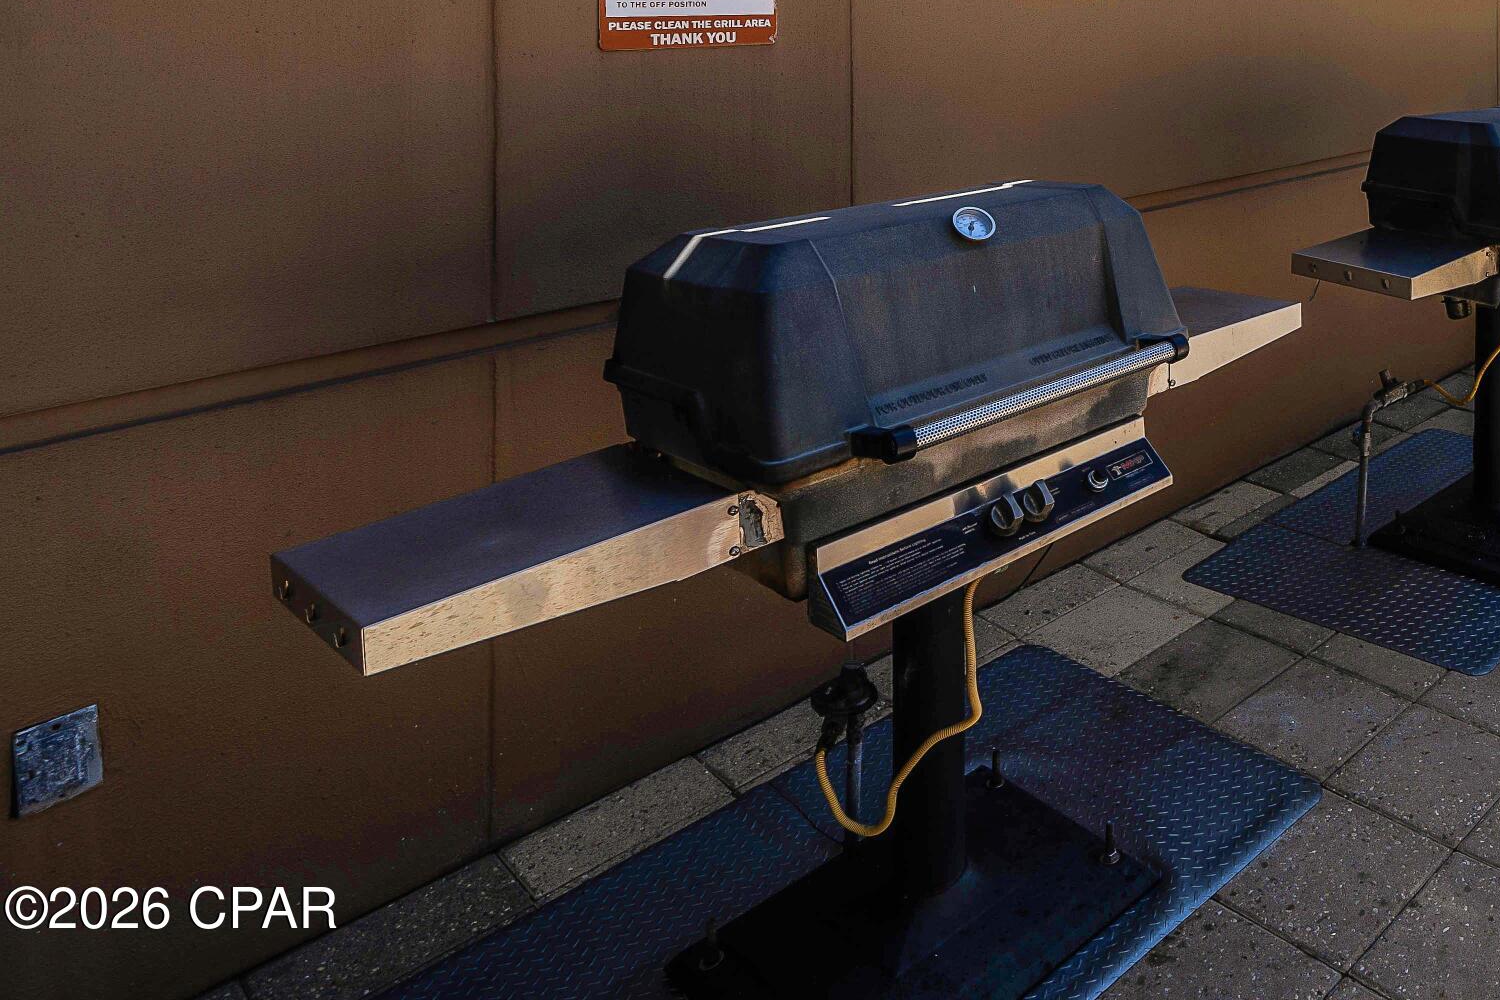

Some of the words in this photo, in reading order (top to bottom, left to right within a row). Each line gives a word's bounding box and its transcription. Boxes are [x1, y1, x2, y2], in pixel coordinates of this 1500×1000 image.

[608, 22, 651, 31] PLEASE
[654, 21, 689, 30] CLEAN
[692, 20, 711, 29] THE
[714, 20, 742, 28] GRILL
[745, 19, 771, 27] AREA
[651, 33, 703, 46] THANK
[707, 32, 736, 43] YOU
